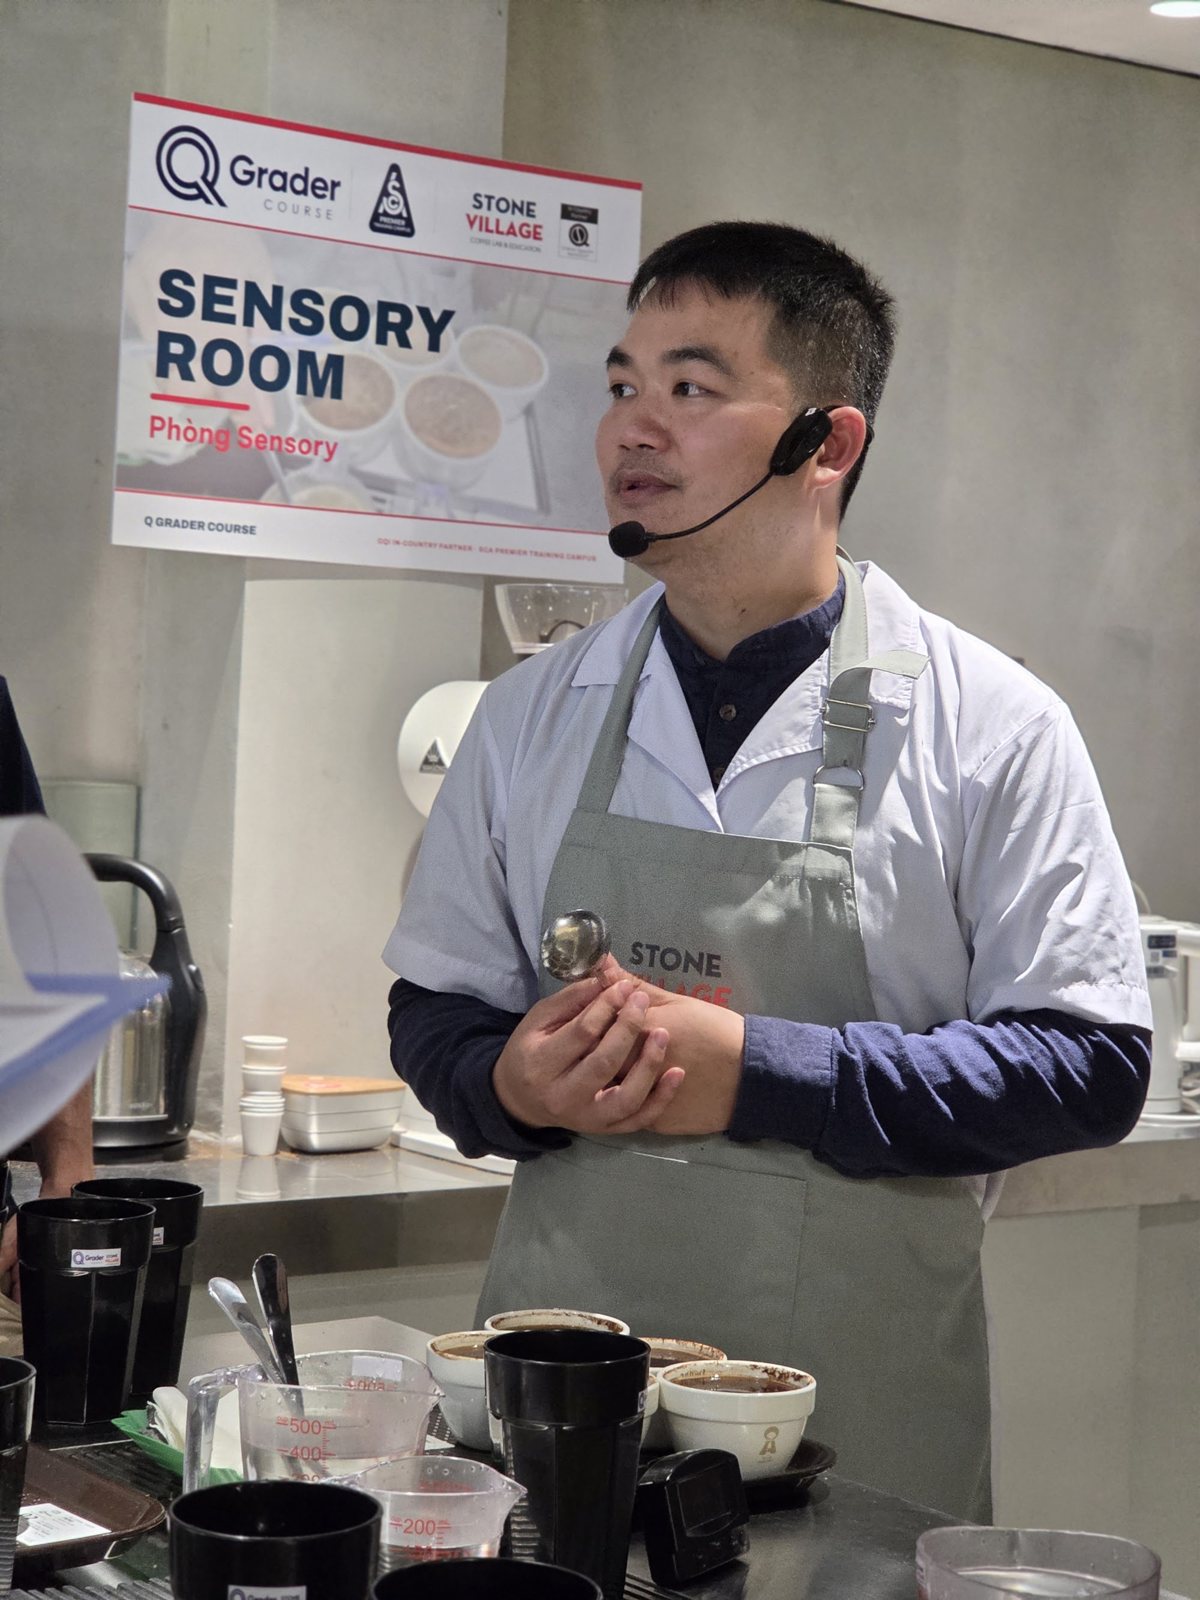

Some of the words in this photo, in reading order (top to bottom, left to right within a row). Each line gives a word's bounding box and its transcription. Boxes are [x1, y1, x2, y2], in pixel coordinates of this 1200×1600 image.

[229, 155, 341, 201] Grader
[263, 199, 334, 221] COURSE
[472, 192, 537, 219] STONE
[466, 212, 544, 241] VILLAGE
[157, 268, 455, 353] SENSORY
[155, 330, 345, 400] ROOM
[149, 415, 230, 452] Phòng
[237, 425, 338, 462] Sensory
[144, 516, 153, 528] Q
[155, 517, 205, 531] GRADER
[207, 521, 257, 535] COURSE
[438, 542, 473, 552] PARTNER
[495, 547, 528, 556] PREMIER
[529, 550, 565, 560] TRAINING
[566, 553, 597, 563] CAMPUS
[629, 941, 722, 978] STONE
[290, 1418, 321, 1435] 500
[290, 1446, 321, 1461] 400
[403, 1518, 436, 1536] 200
